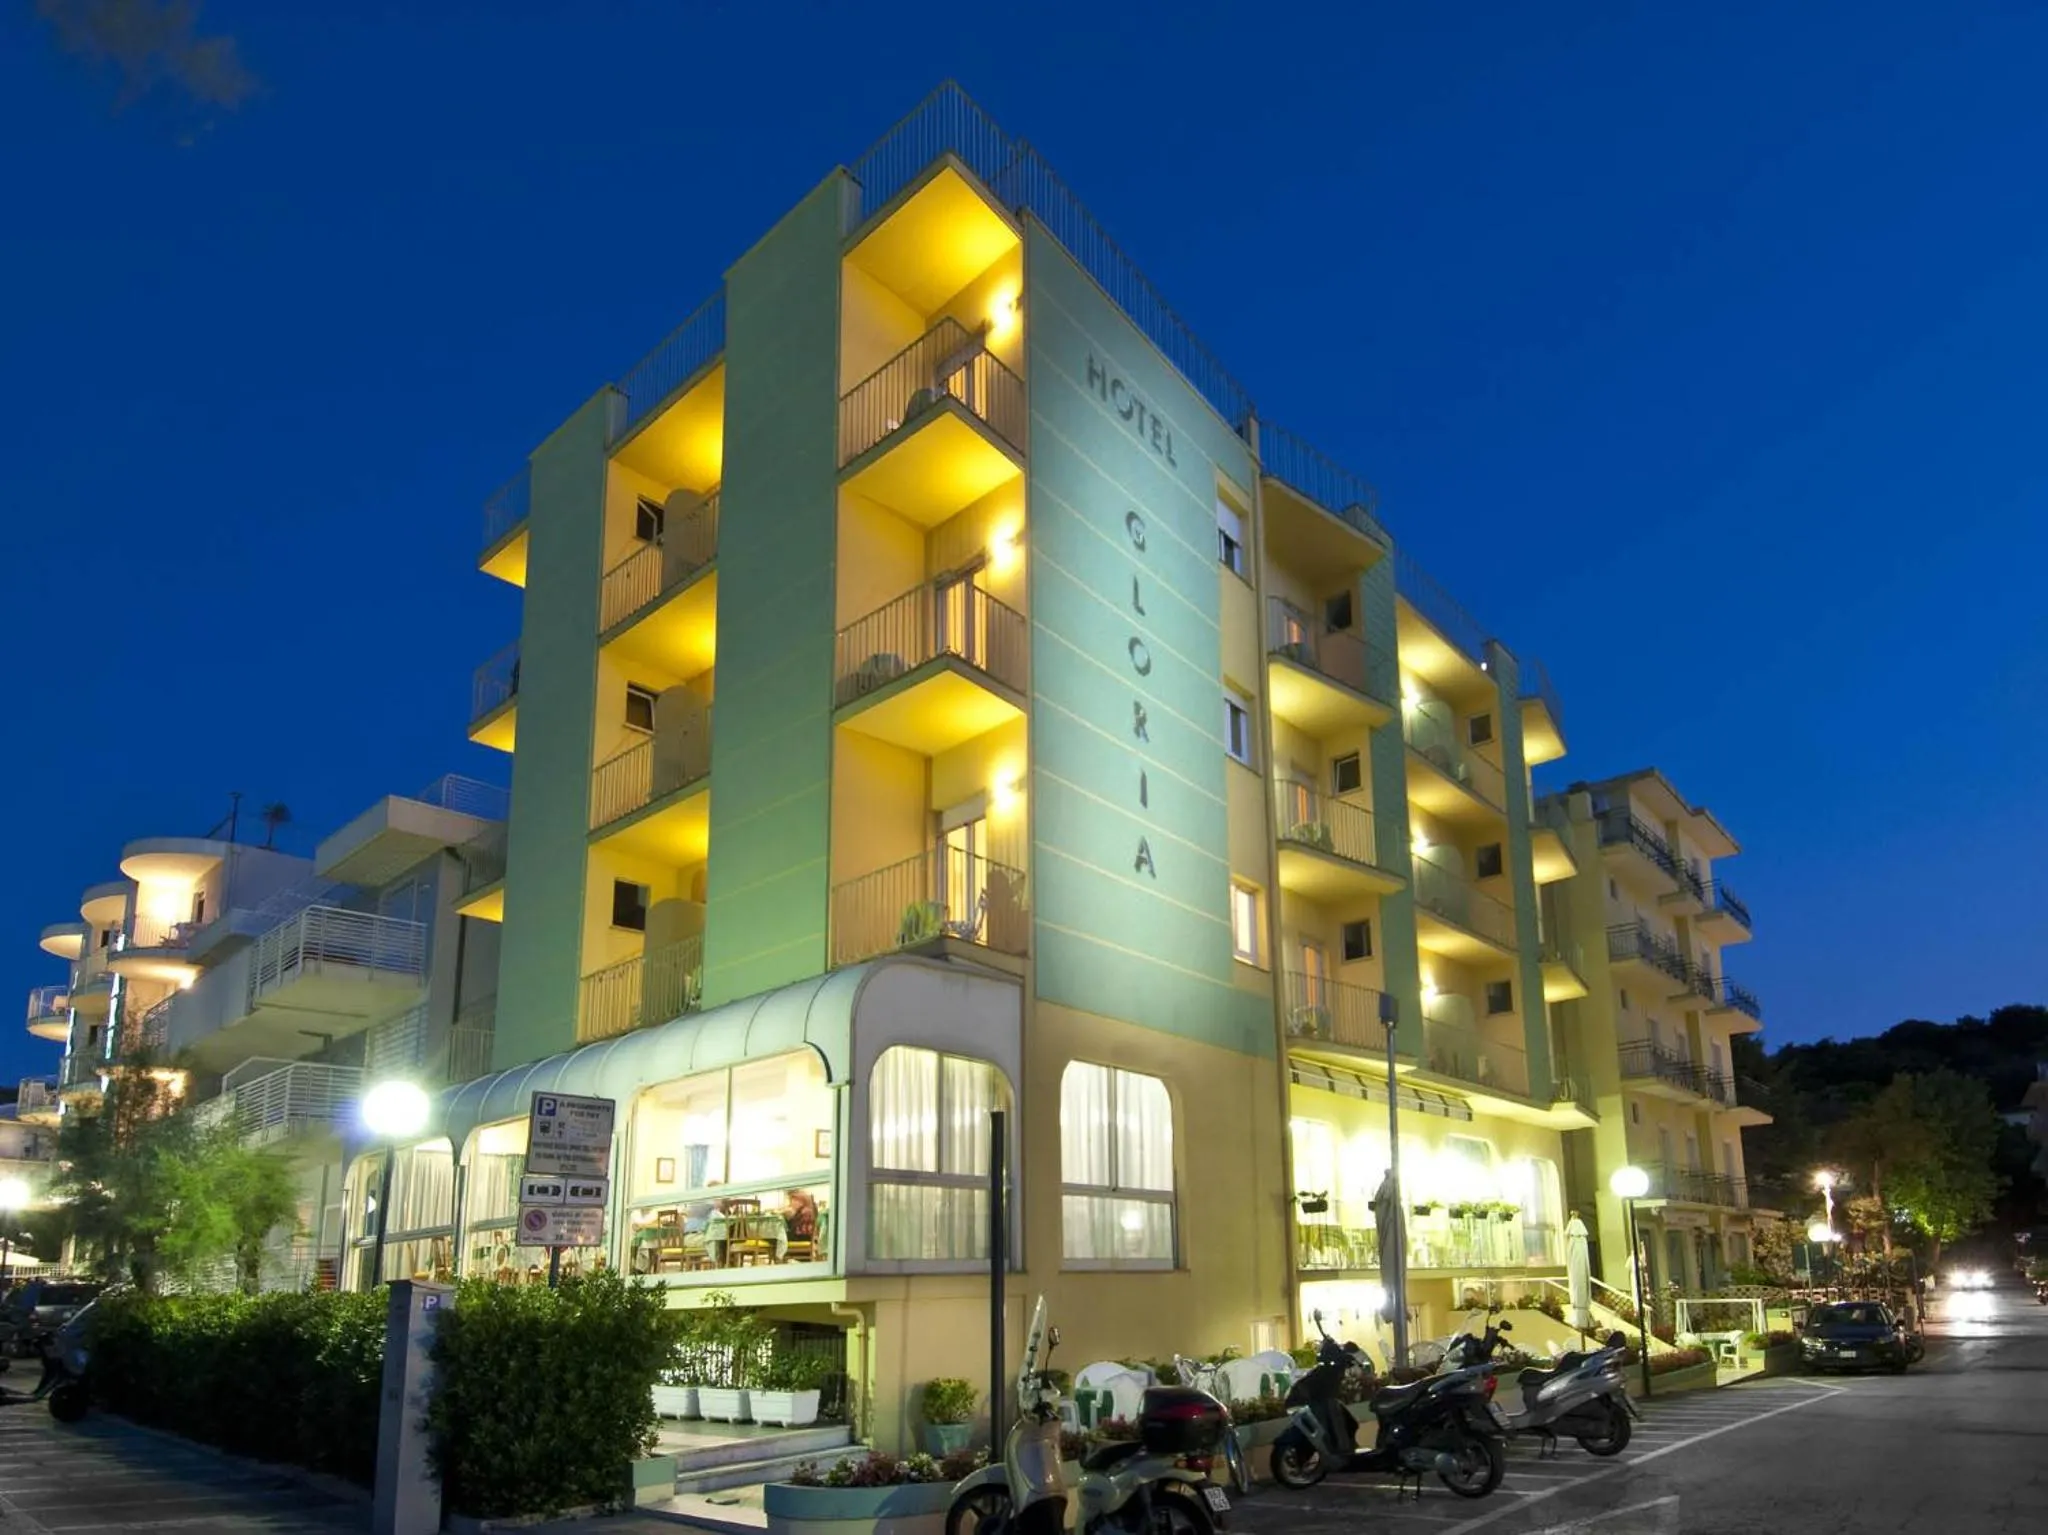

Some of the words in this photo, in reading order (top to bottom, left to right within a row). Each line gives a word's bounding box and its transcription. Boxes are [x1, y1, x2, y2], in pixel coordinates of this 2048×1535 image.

[1086, 351, 1177, 470] HOTEL
[1125, 510, 1156, 880] GLORIA
[541, 1099, 554, 1114] P
[425, 1295, 438, 1310] P
